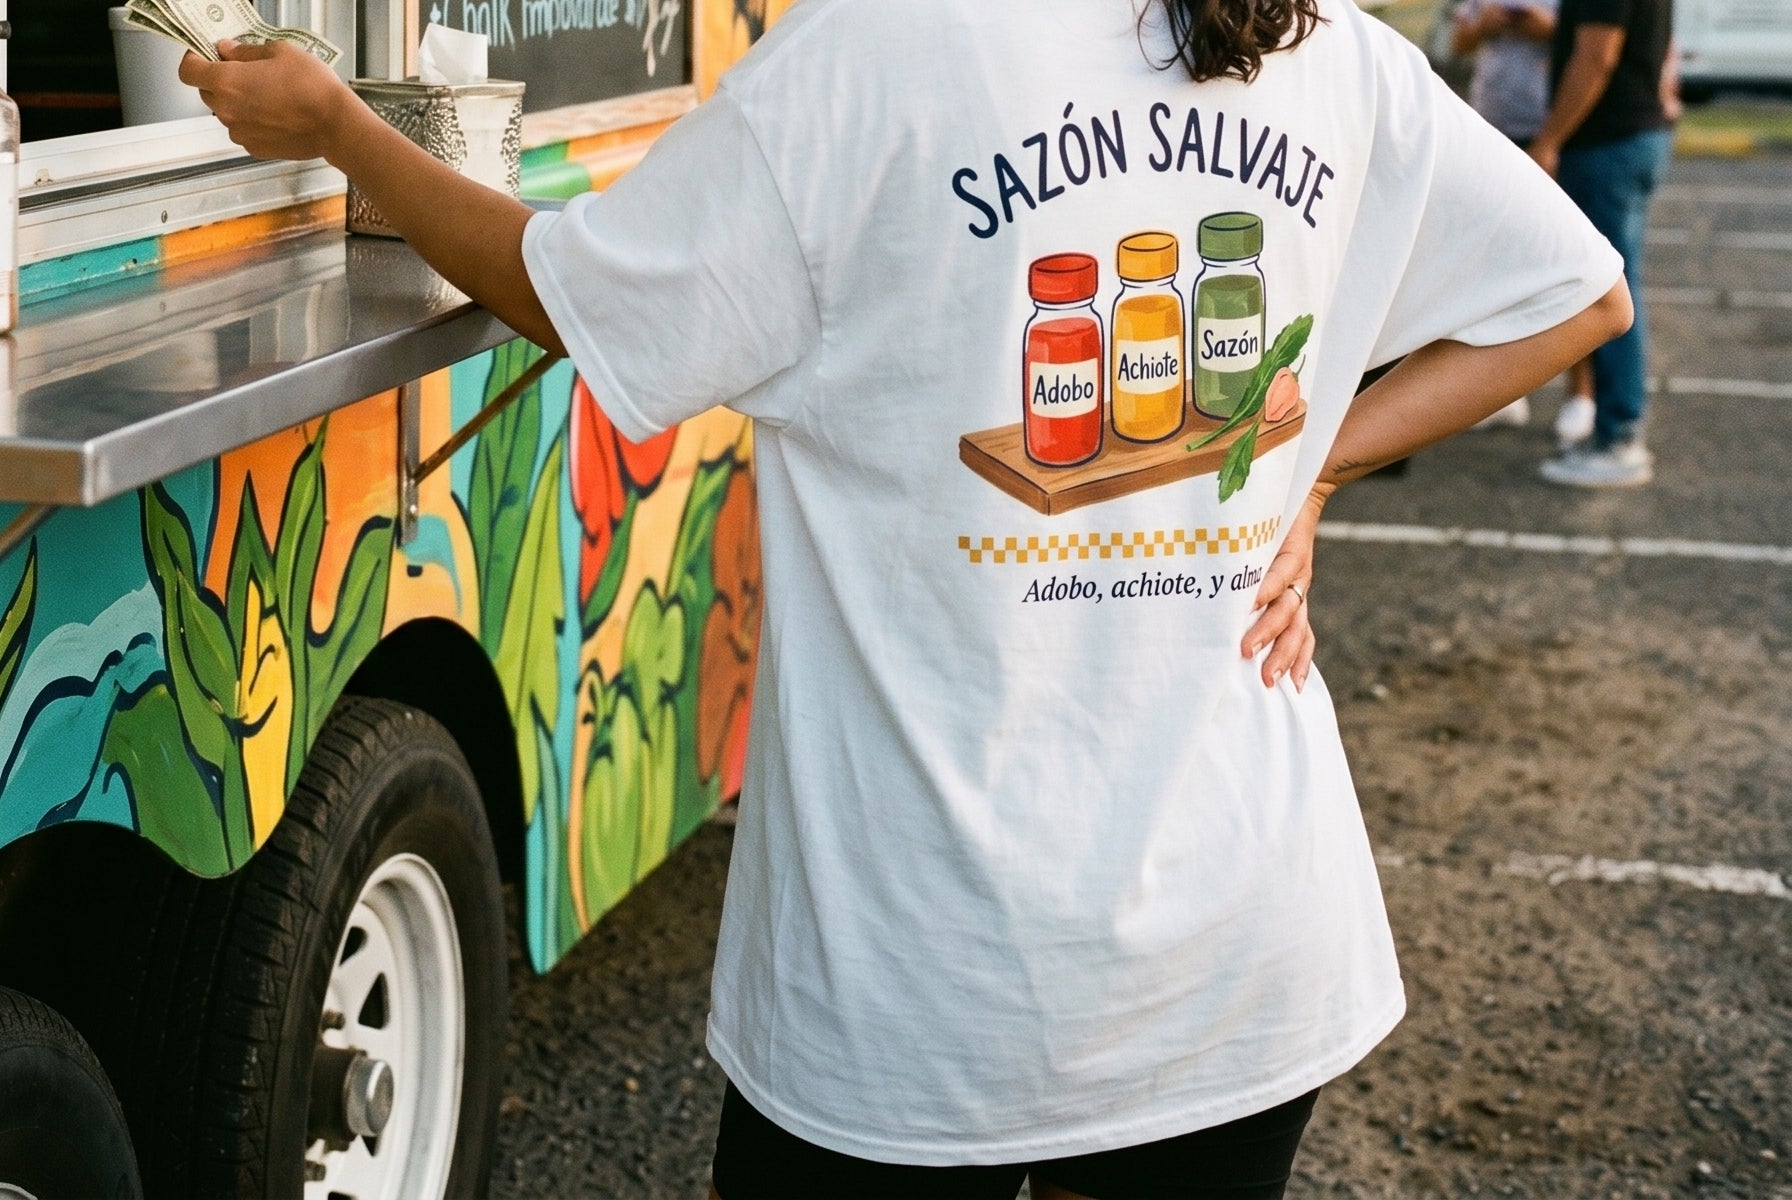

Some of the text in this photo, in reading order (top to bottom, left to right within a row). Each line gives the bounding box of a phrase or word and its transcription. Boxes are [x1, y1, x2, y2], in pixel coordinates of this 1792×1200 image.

[952, 102, 1335, 239] SAZÓN SALVAJE
[1201, 329, 1259, 360] Sazón
[1117, 351, 1179, 382] Achiote
[1033, 374, 1094, 405] Adobo
[1022, 575, 1104, 604] Adobo,
[1111, 571, 1202, 598] achiote,
[1208, 575, 1225, 599] y
